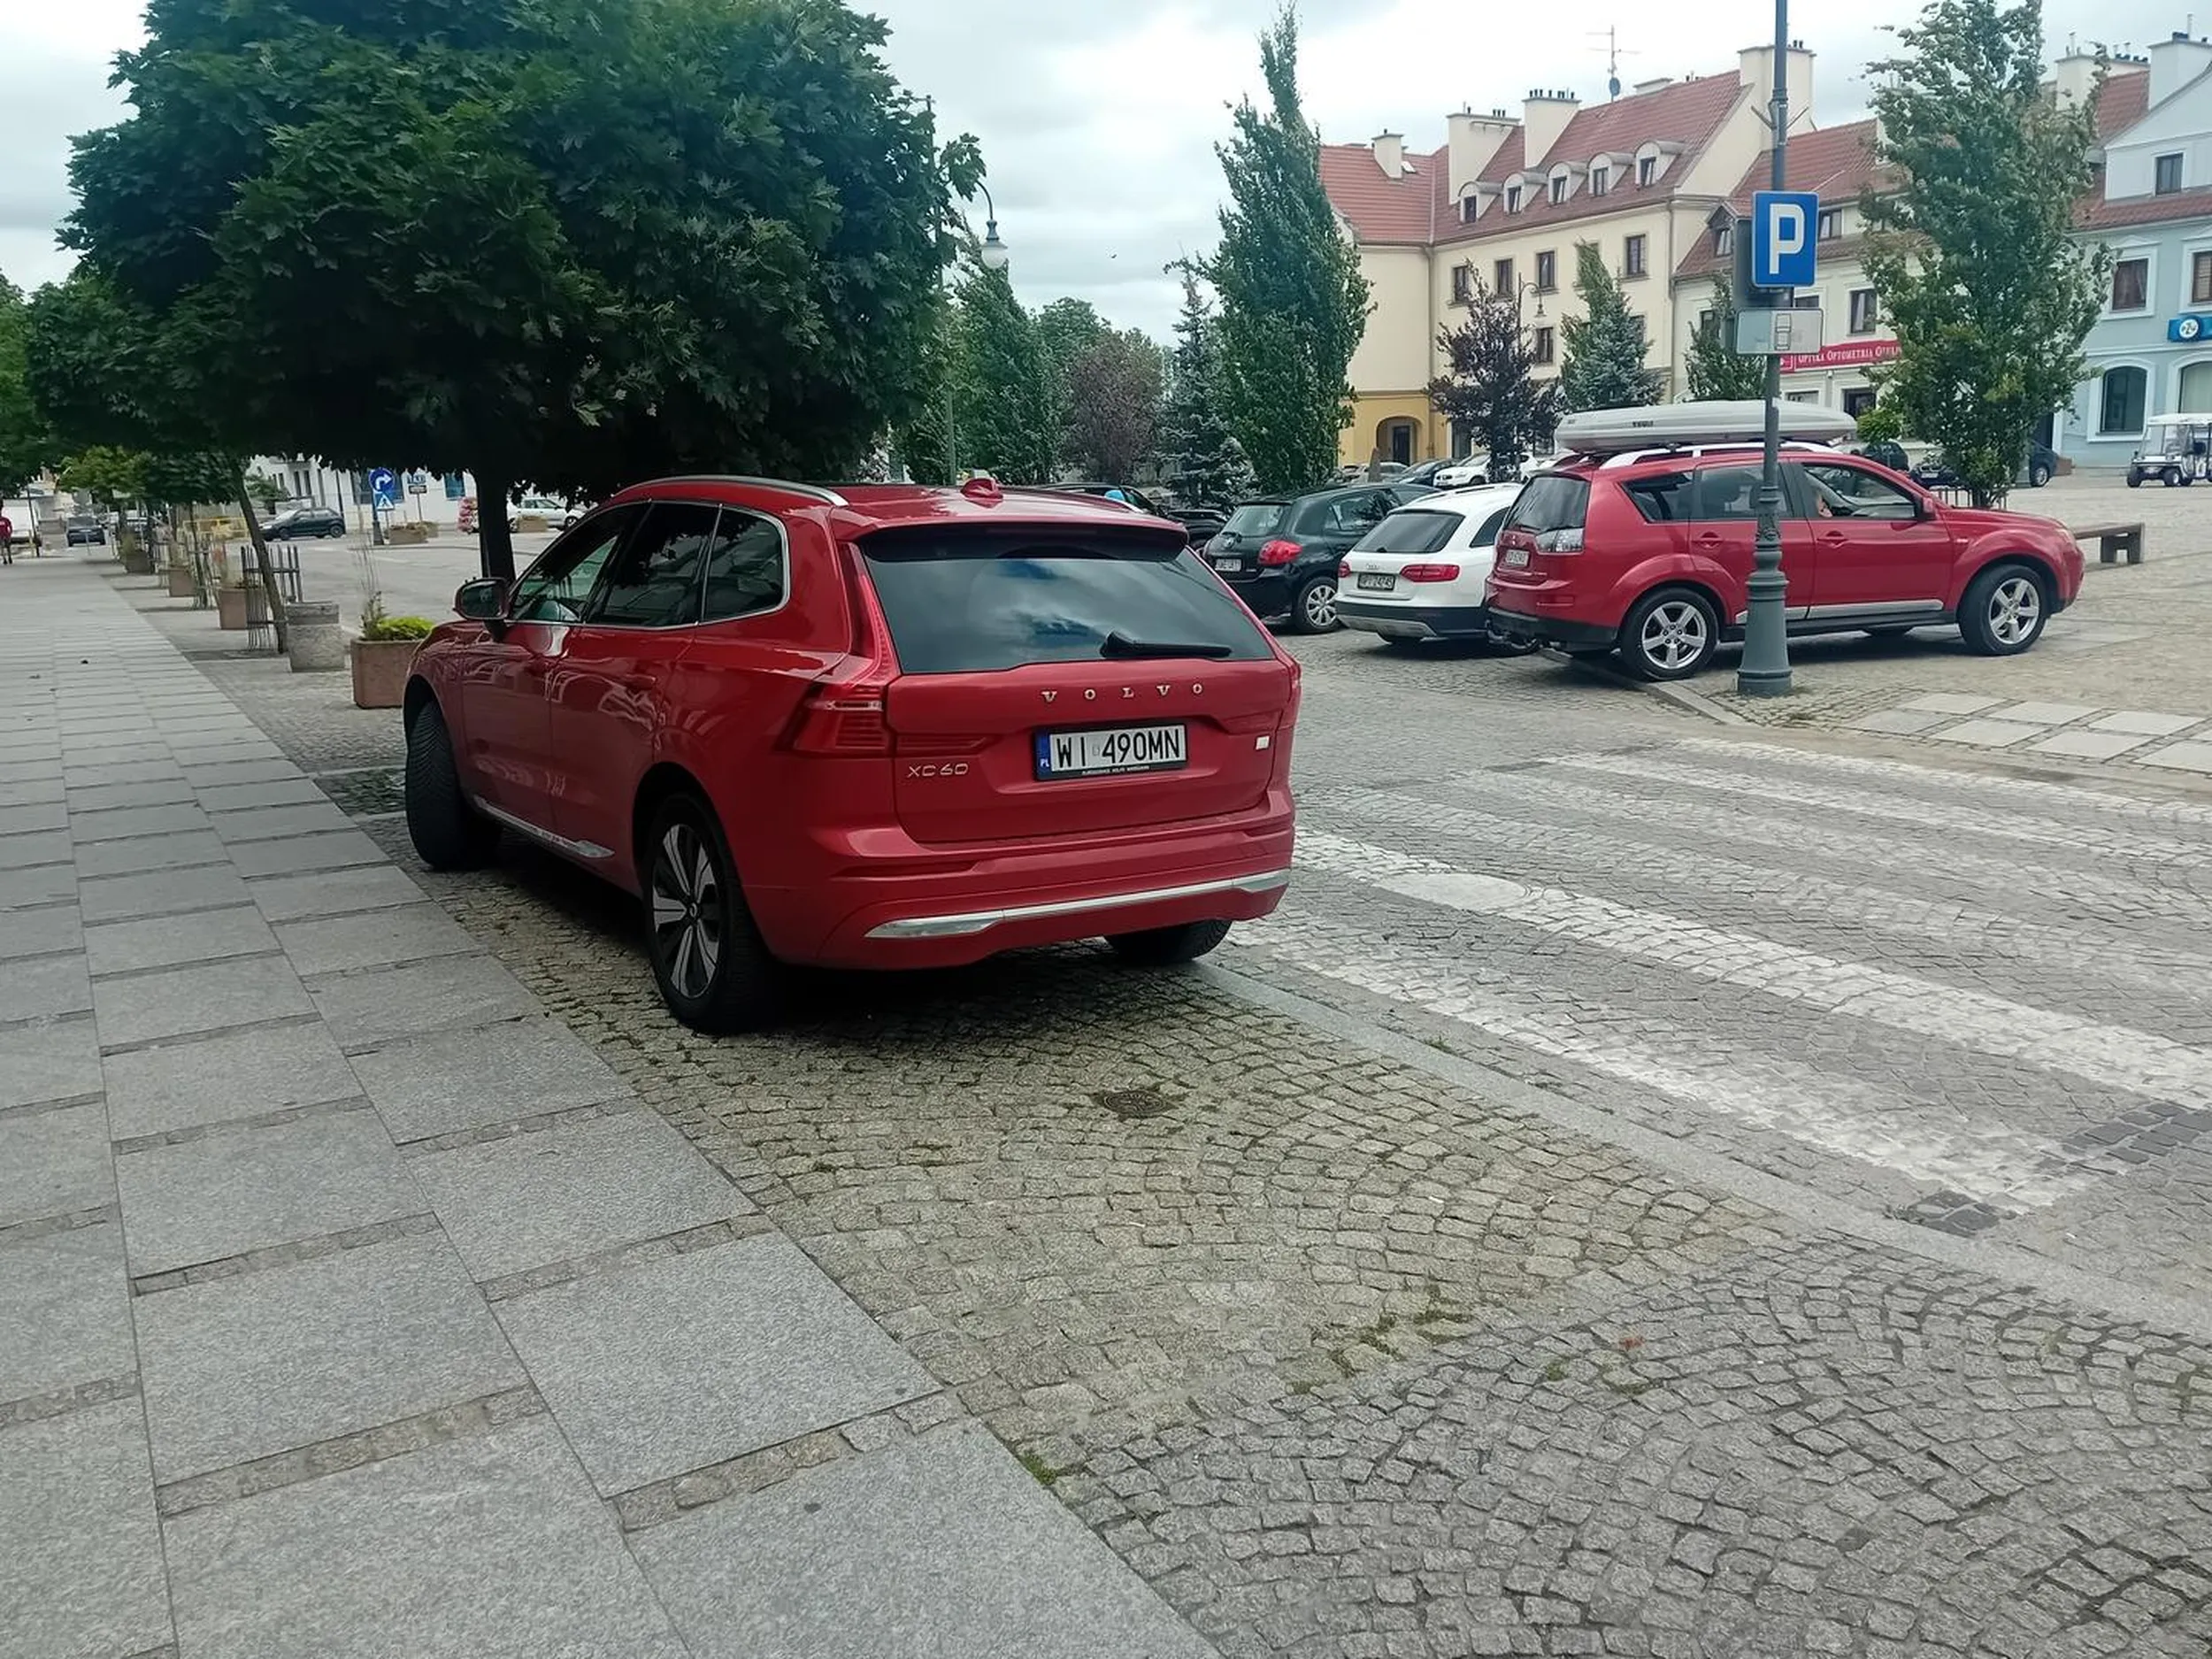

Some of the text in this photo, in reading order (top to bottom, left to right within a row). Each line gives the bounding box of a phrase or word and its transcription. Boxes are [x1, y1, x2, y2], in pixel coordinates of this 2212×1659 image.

[1770, 203, 1804, 274] P
[1041, 683, 1203, 703] VOLVO
[1056, 728, 1180, 769] WI 490MN
[907, 763, 969, 778] XC60
[1040, 758, 1050, 768] PL
